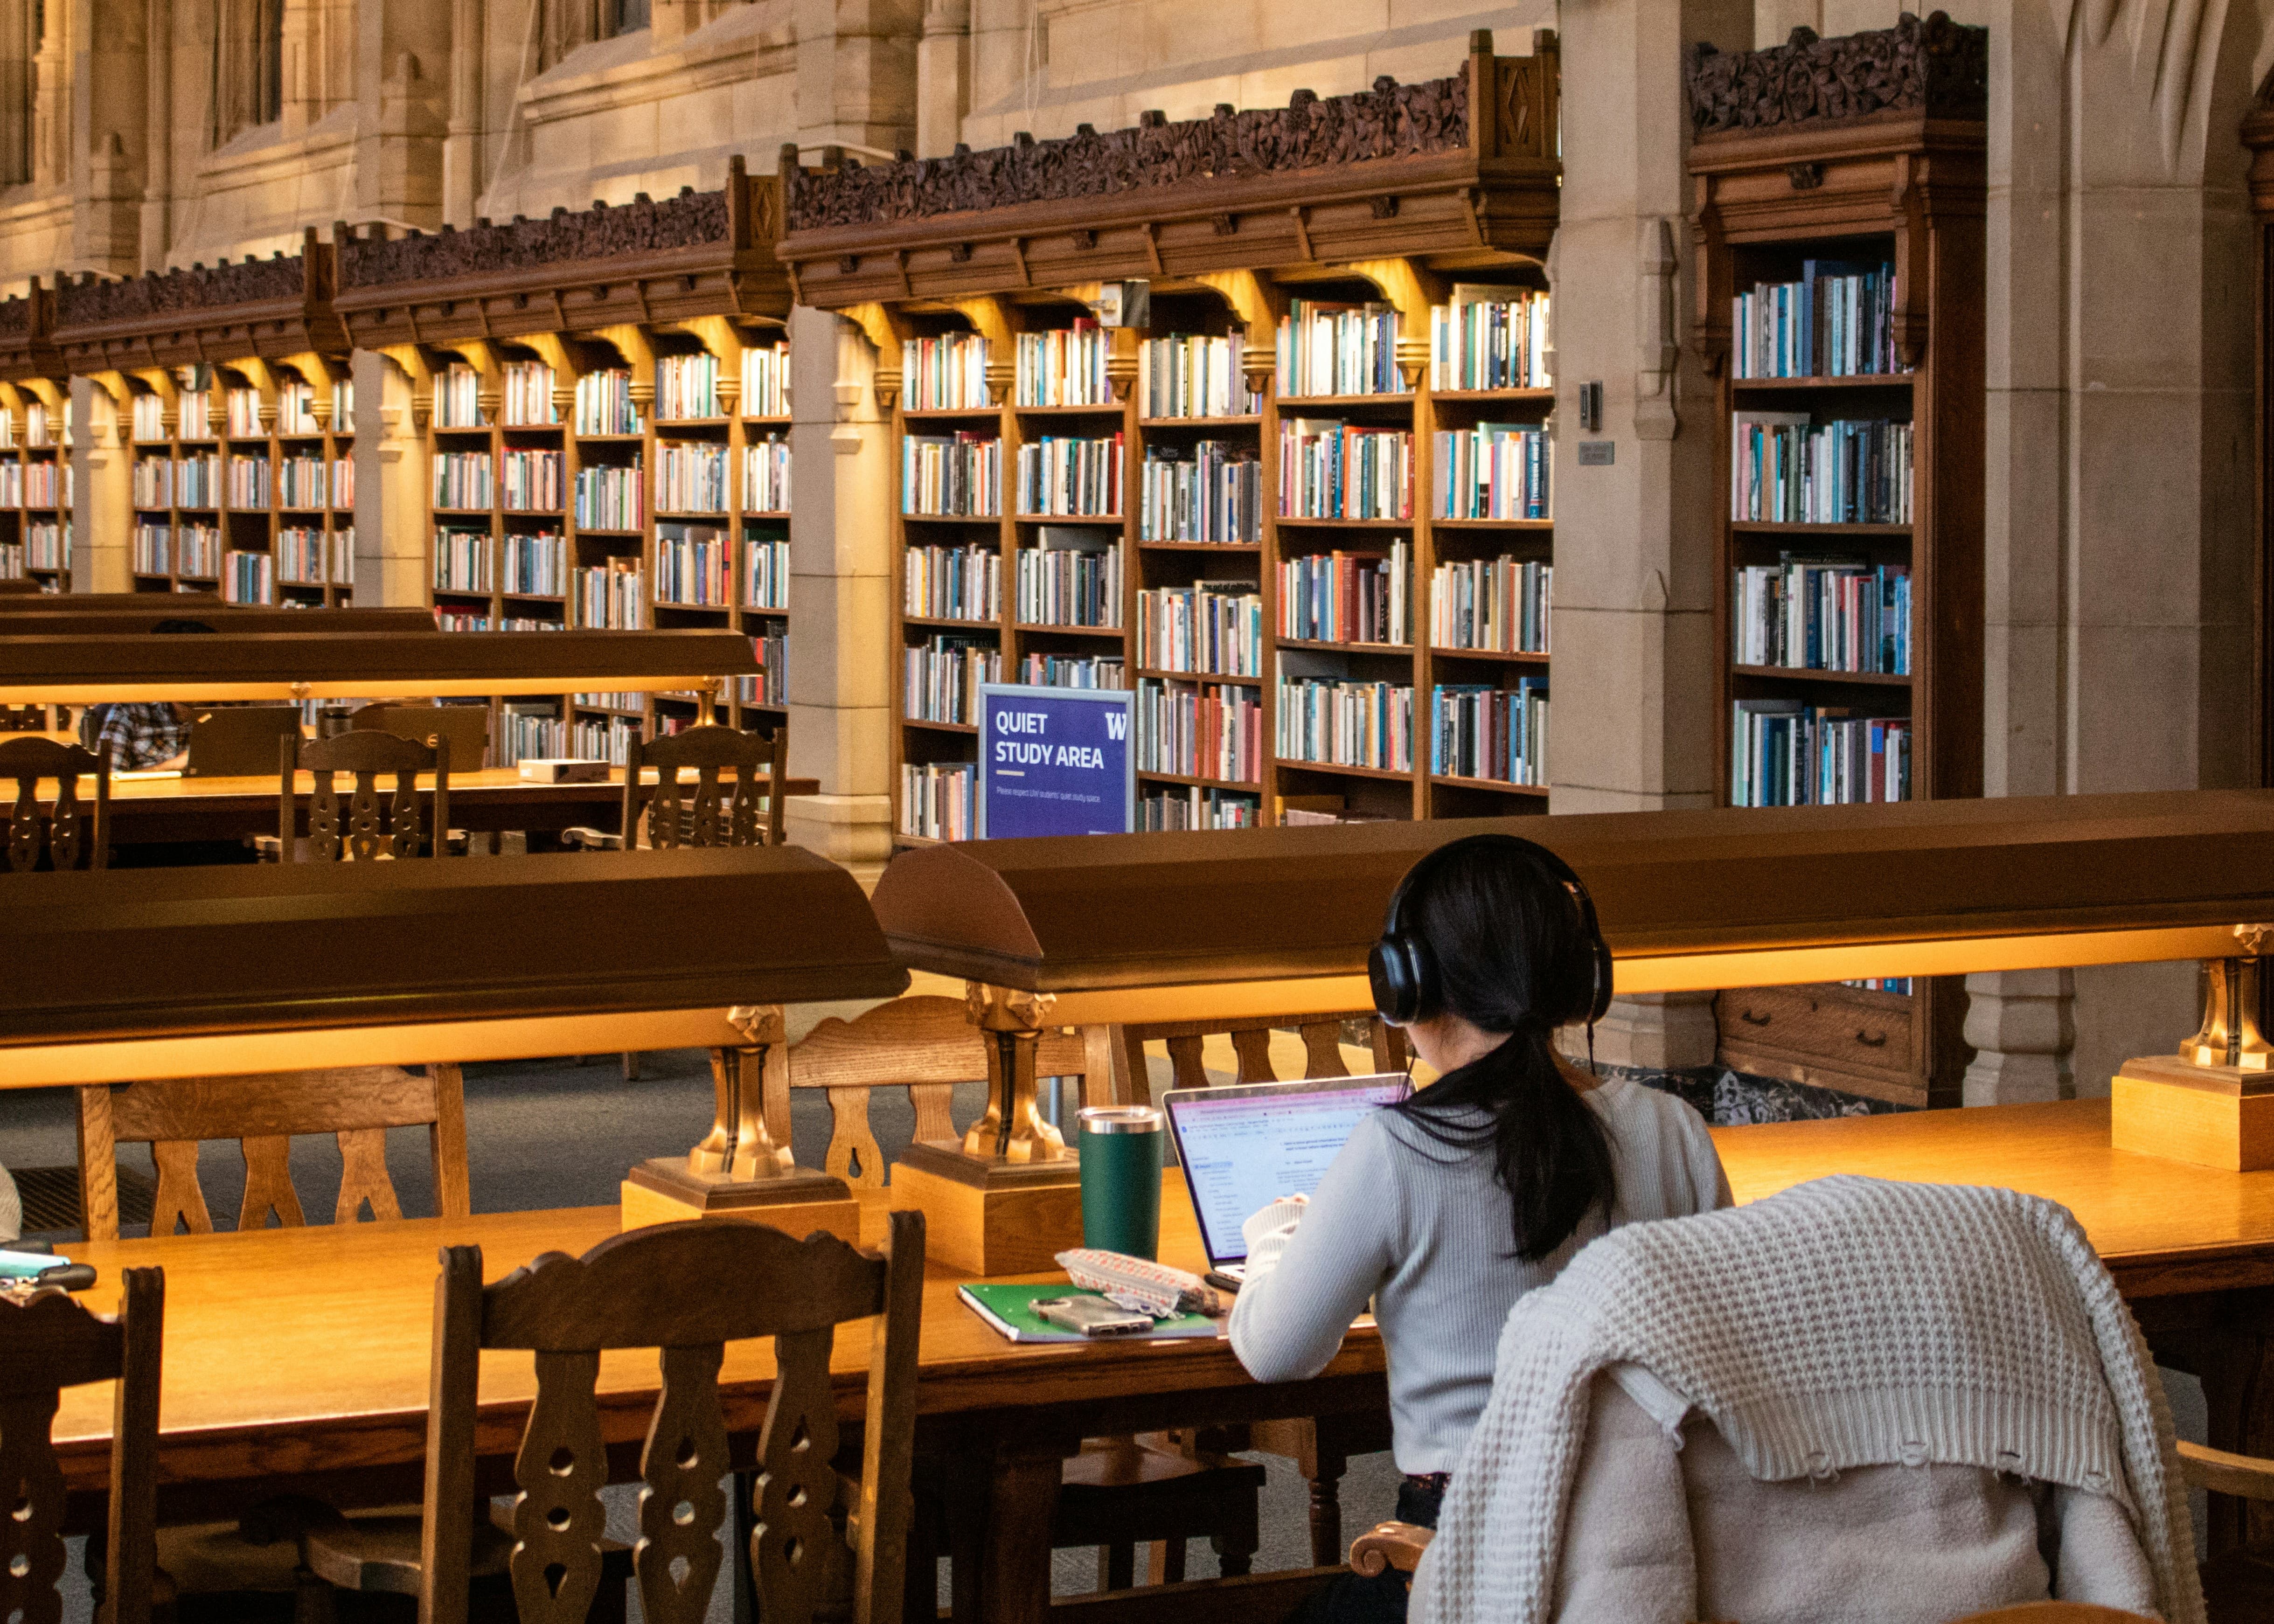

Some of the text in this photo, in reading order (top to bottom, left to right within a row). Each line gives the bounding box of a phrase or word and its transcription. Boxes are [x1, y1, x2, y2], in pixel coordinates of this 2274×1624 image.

[996, 711, 1048, 735] QUIET
[1105, 712, 1127, 740] W
[995, 741, 1104, 769] STUDY AREA
[996, 786, 1012, 795] Please
[1013, 789, 1029, 798] respect
[1072, 793, 1085, 803] study
